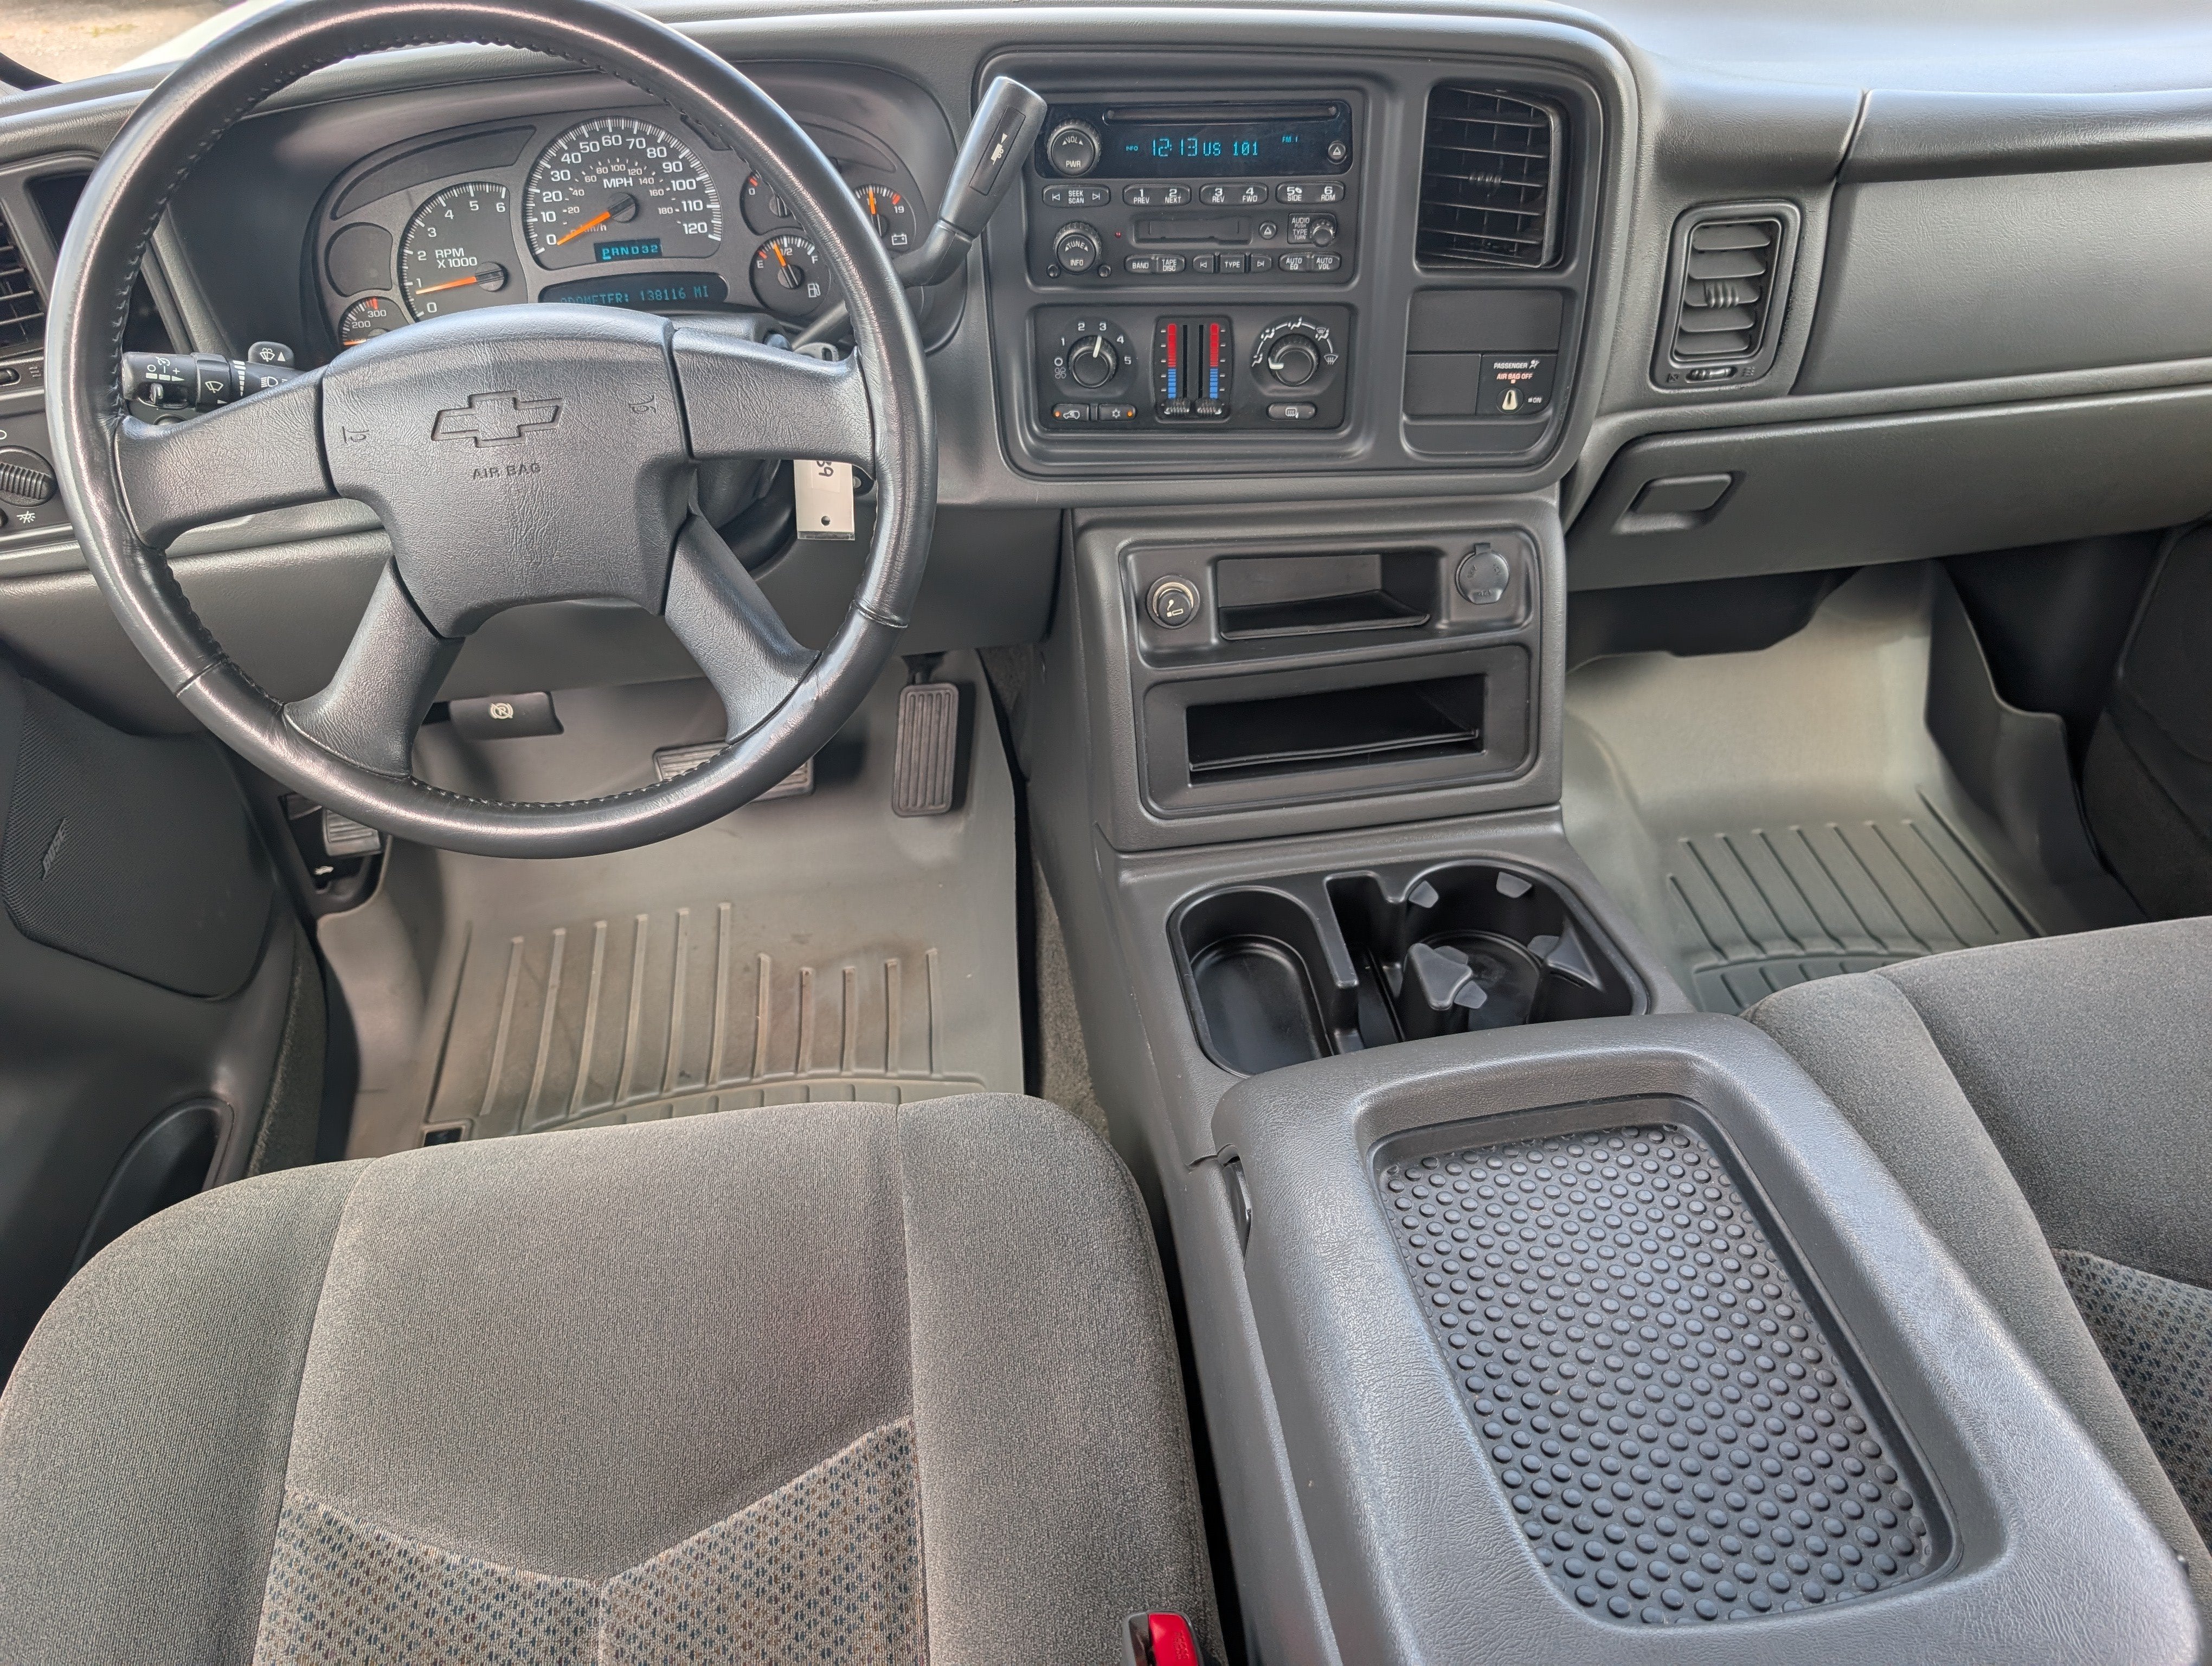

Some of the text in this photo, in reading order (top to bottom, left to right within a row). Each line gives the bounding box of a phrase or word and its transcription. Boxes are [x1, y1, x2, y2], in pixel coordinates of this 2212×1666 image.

[601, 134, 622, 146] 60
[626, 138, 646, 150] 70
[1066, 136, 1079, 144] VOL
[579, 142, 600, 153] 50
[647, 146, 667, 158] 80
[1152, 138, 1198, 157] 12:13
[1203, 141, 1258, 156] US 101
[561, 152, 582, 164] 40
[627, 168, 642, 176] 120
[663, 161, 683, 173] 90
[550, 170, 571, 182] 30
[603, 177, 633, 189] MPH
[671, 178, 697, 191] 100
[1139, 189, 1144, 197] 1
[1169, 189, 1178, 197] 2
[1214, 188, 1223, 196] 3
[1245, 187, 1254, 196] 4
[1287, 187, 1295, 196] 5
[1324, 186, 1333, 195] 6
[542, 190, 563, 203] 20
[1133, 196, 1150, 204] PREV
[1242, 195, 1257, 203] FWD
[1321, 194, 1335, 202] RDM
[469, 201, 479, 211] 5
[496, 202, 506, 213] 6
[567, 206, 580, 214] 20
[658, 207, 673, 215] 180
[681, 200, 703, 212] 110
[894, 206, 904, 214] 19
[445, 209, 454, 220] 4
[541, 211, 557, 223] 10
[427, 227, 437, 238] 3
[683, 222, 708, 235] 120
[546, 234, 557, 245] 0
[1067, 240, 1085, 249] TUNE
[417, 251, 427, 261] 2
[435, 248, 465, 259] RPM
[757, 260, 763, 268] E
[811, 255, 818, 264] F
[416, 278, 422, 288] 1
[640, 287, 686, 301] 138116
[427, 302, 438, 313] 0
[368, 310, 387, 318] 300
[352, 321, 371, 329] 200
[1078, 321, 1085, 331] 2
[1099, 321, 1107, 331] 3
[1061, 337, 1065, 346] 1
[1116, 335, 1124, 344] 4
[1124, 356, 1131, 365] 5
[473, 463, 541, 480] AIR BAG
